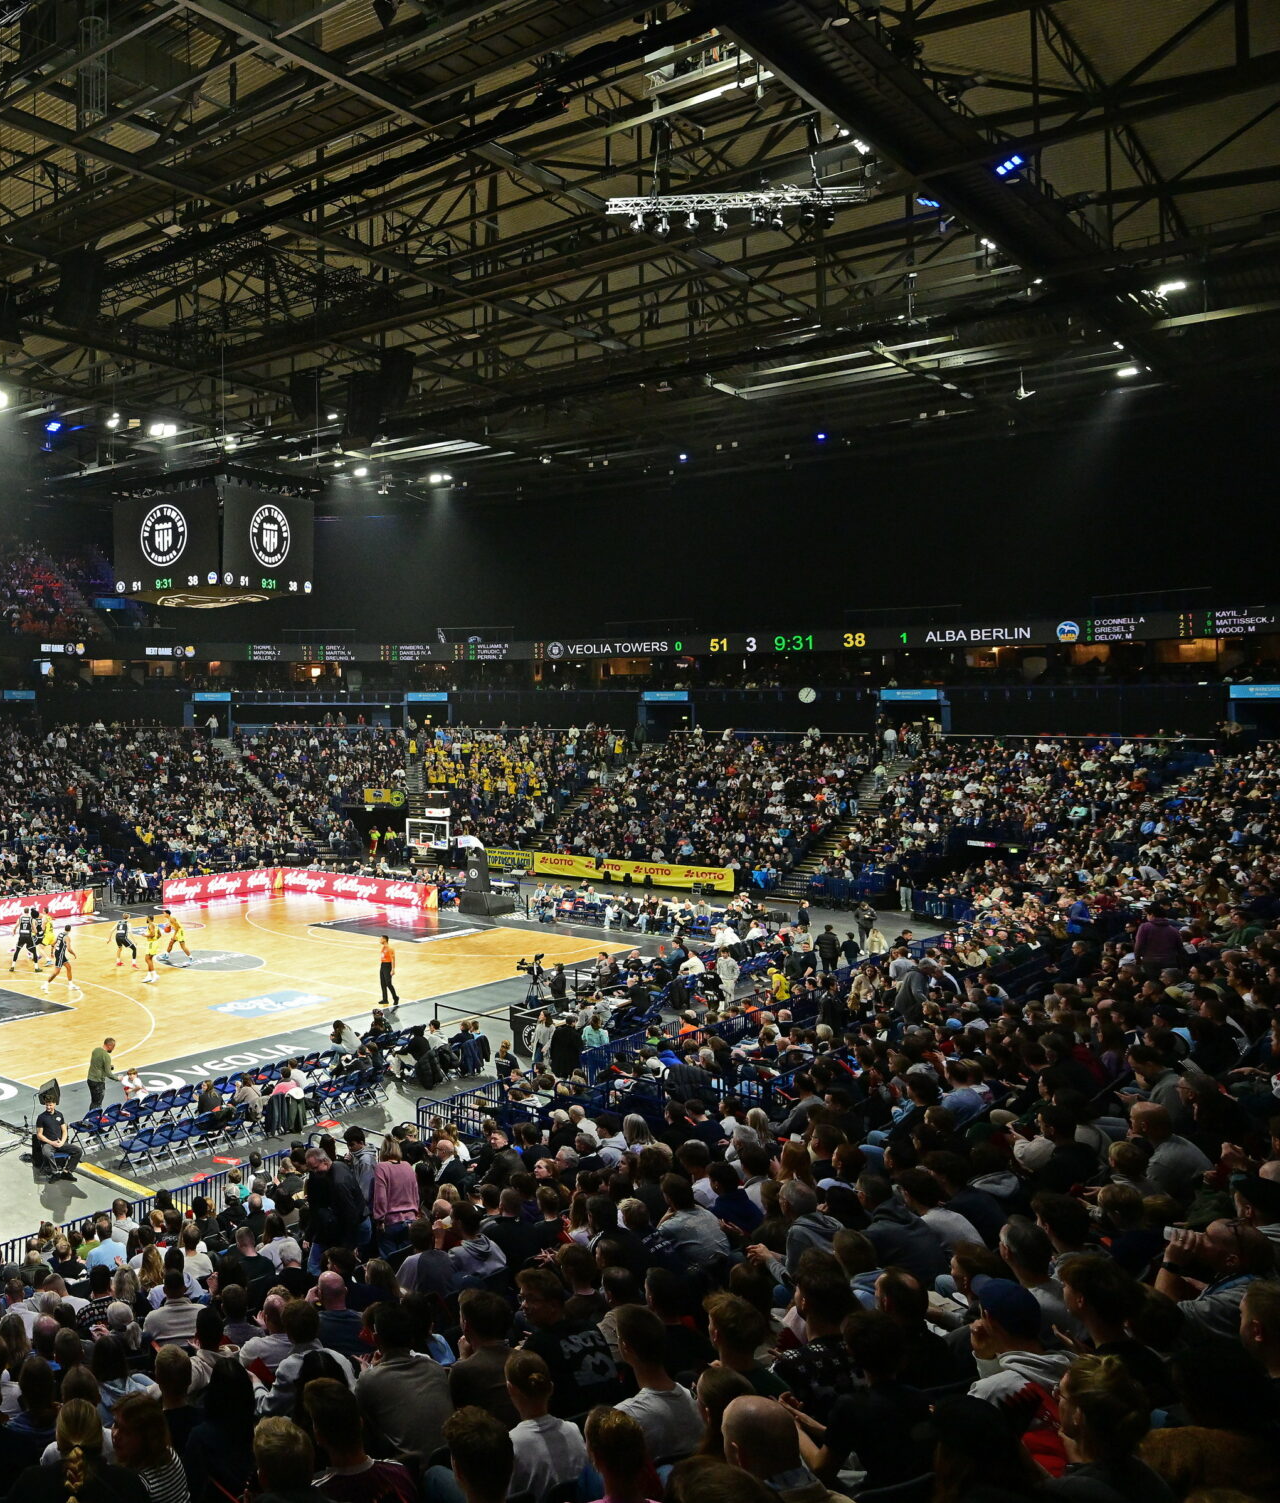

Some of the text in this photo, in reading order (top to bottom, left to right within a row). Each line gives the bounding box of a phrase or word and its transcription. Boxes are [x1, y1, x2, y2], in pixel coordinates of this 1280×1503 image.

[143, 507, 184, 537] VEOLIA TOWERS
[252, 509, 269, 533] VEOLIA
[132, 575, 198, 591] 51 9:31 38
[240, 576, 298, 591] 51 9:31 38
[1216, 616, 1269, 626] MATTISSECK,
[1216, 626, 1246, 634] WOOD,
[567, 643, 612, 654] VEOLIA
[614, 642, 668, 653] TOWERS
[675, 641, 682, 651] 0
[709, 638, 728, 652] 51
[746, 637, 757, 652] 3
[774, 635, 814, 651] 9:31
[843, 633, 866, 647] 38
[900, 632, 907, 644] 1
[925, 630, 967, 643] ALBA
[970, 627, 1031, 641] BERLIN
[549, 857, 573, 866] LOTTO
[598, 862, 622, 871] OTTO
[643, 865, 671, 876] LOTTO
[695, 870, 724, 880] LOTTO
[207, 876, 242, 894] Kellogg's
[284, 871, 327, 891] Kellogg's
[332, 877, 379, 898] Kellogg's
[165, 881, 202, 899] Kellogg's
[175, 1043, 310, 1077] VEOLIA
